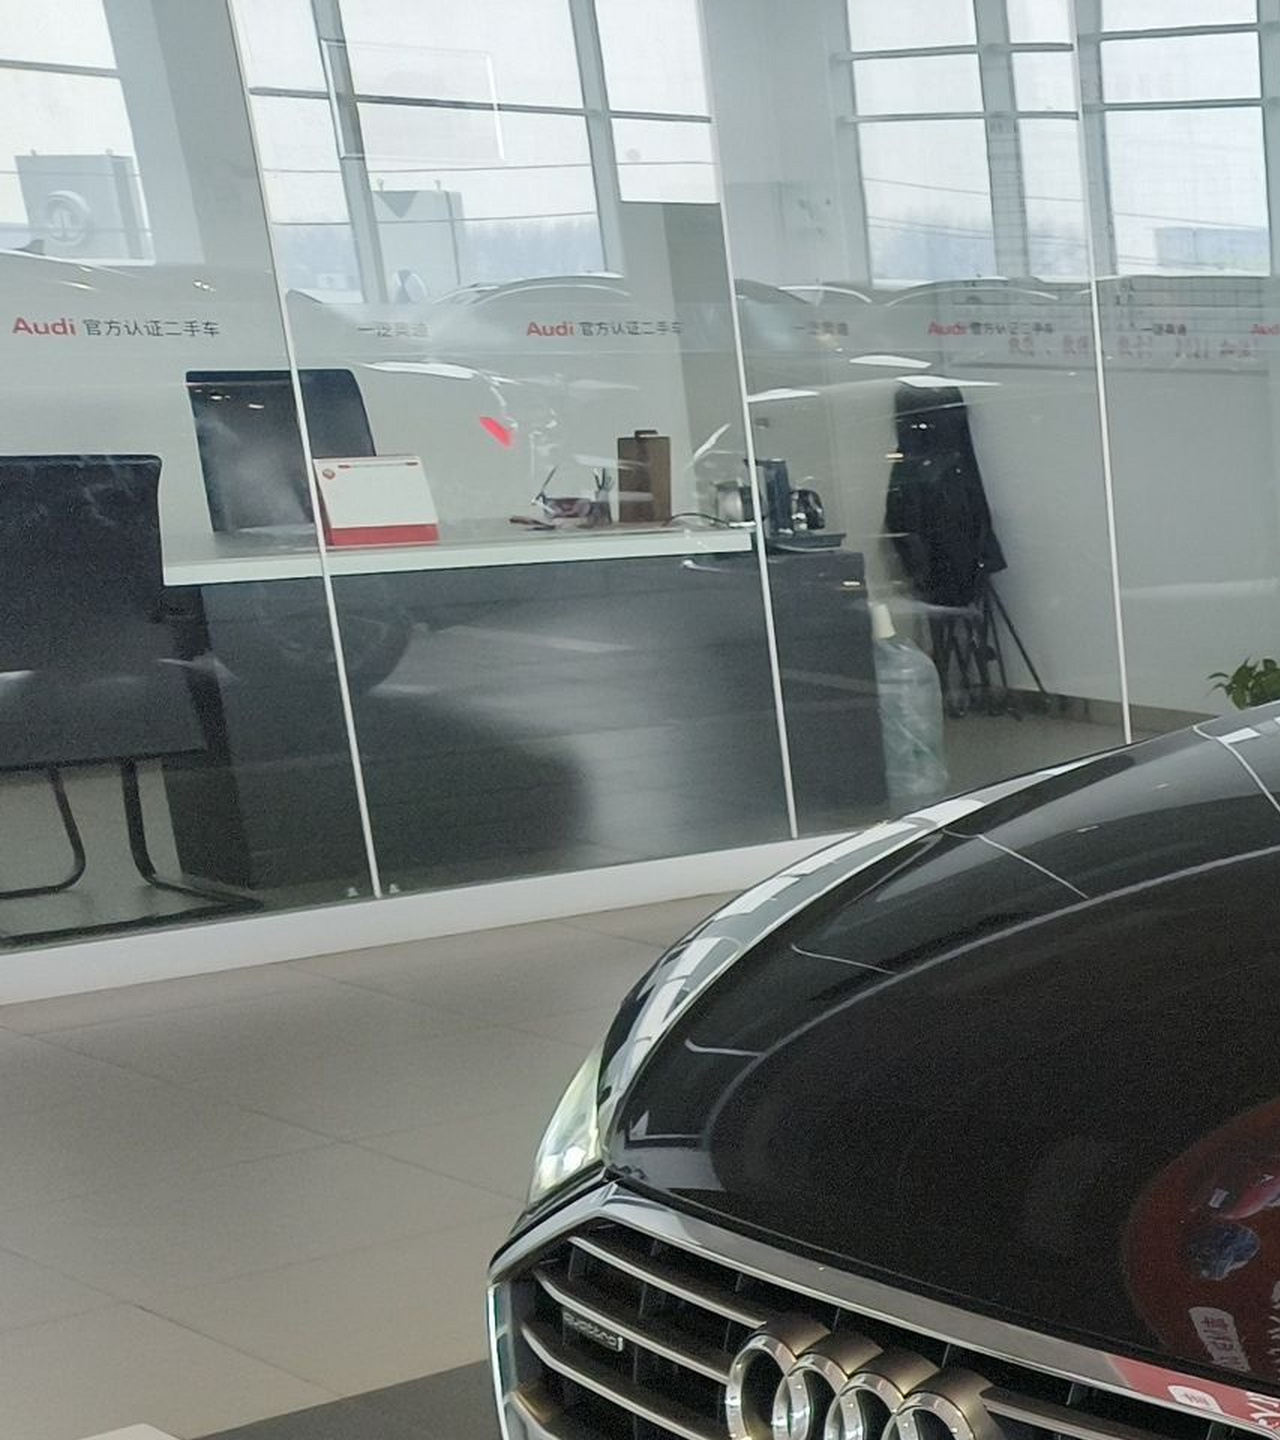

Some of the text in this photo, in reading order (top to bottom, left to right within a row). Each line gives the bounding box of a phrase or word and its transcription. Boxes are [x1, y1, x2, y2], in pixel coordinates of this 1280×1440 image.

[12, 317, 220, 337] Audi 官方认证二手车
[527, 321, 575, 336] Audi
